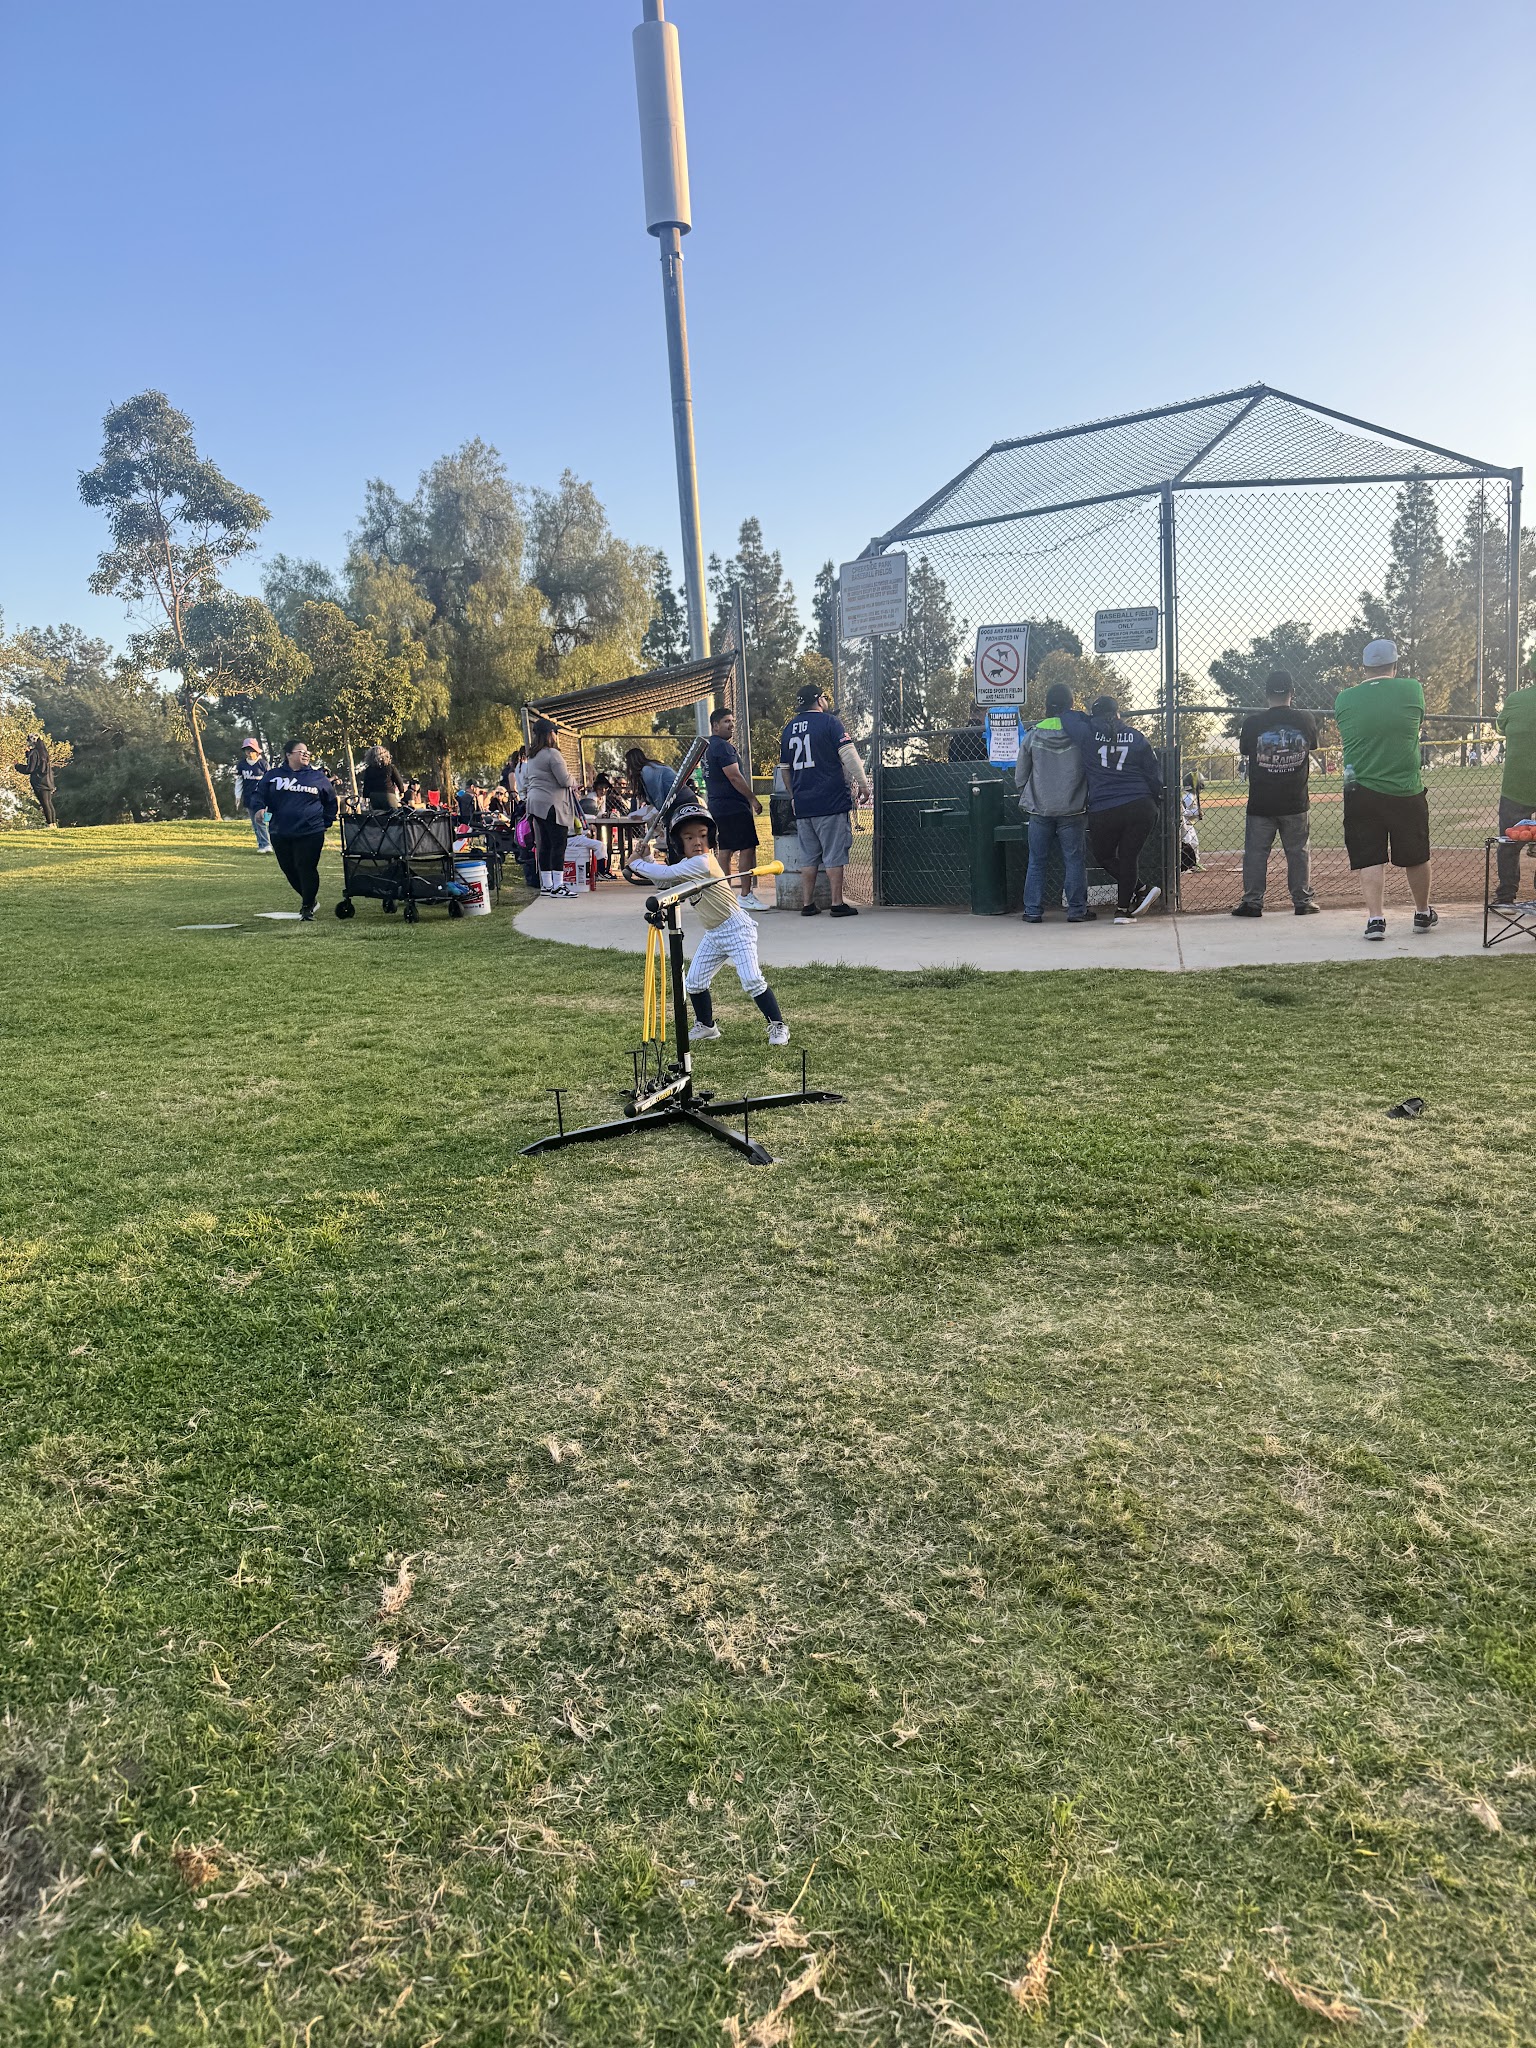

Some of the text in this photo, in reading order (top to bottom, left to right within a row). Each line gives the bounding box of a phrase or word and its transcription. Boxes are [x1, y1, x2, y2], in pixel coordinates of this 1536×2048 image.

[878, 560, 892, 569] PARK
[852, 567, 893, 581] BASEBALL FIELDS
[1099, 612, 1134, 620] BASEBALL
[985, 634, 1013, 642] PROHIBITED
[791, 720, 809, 734] FIG
[788, 733, 816, 771] 21
[1097, 745, 1129, 771] 17
